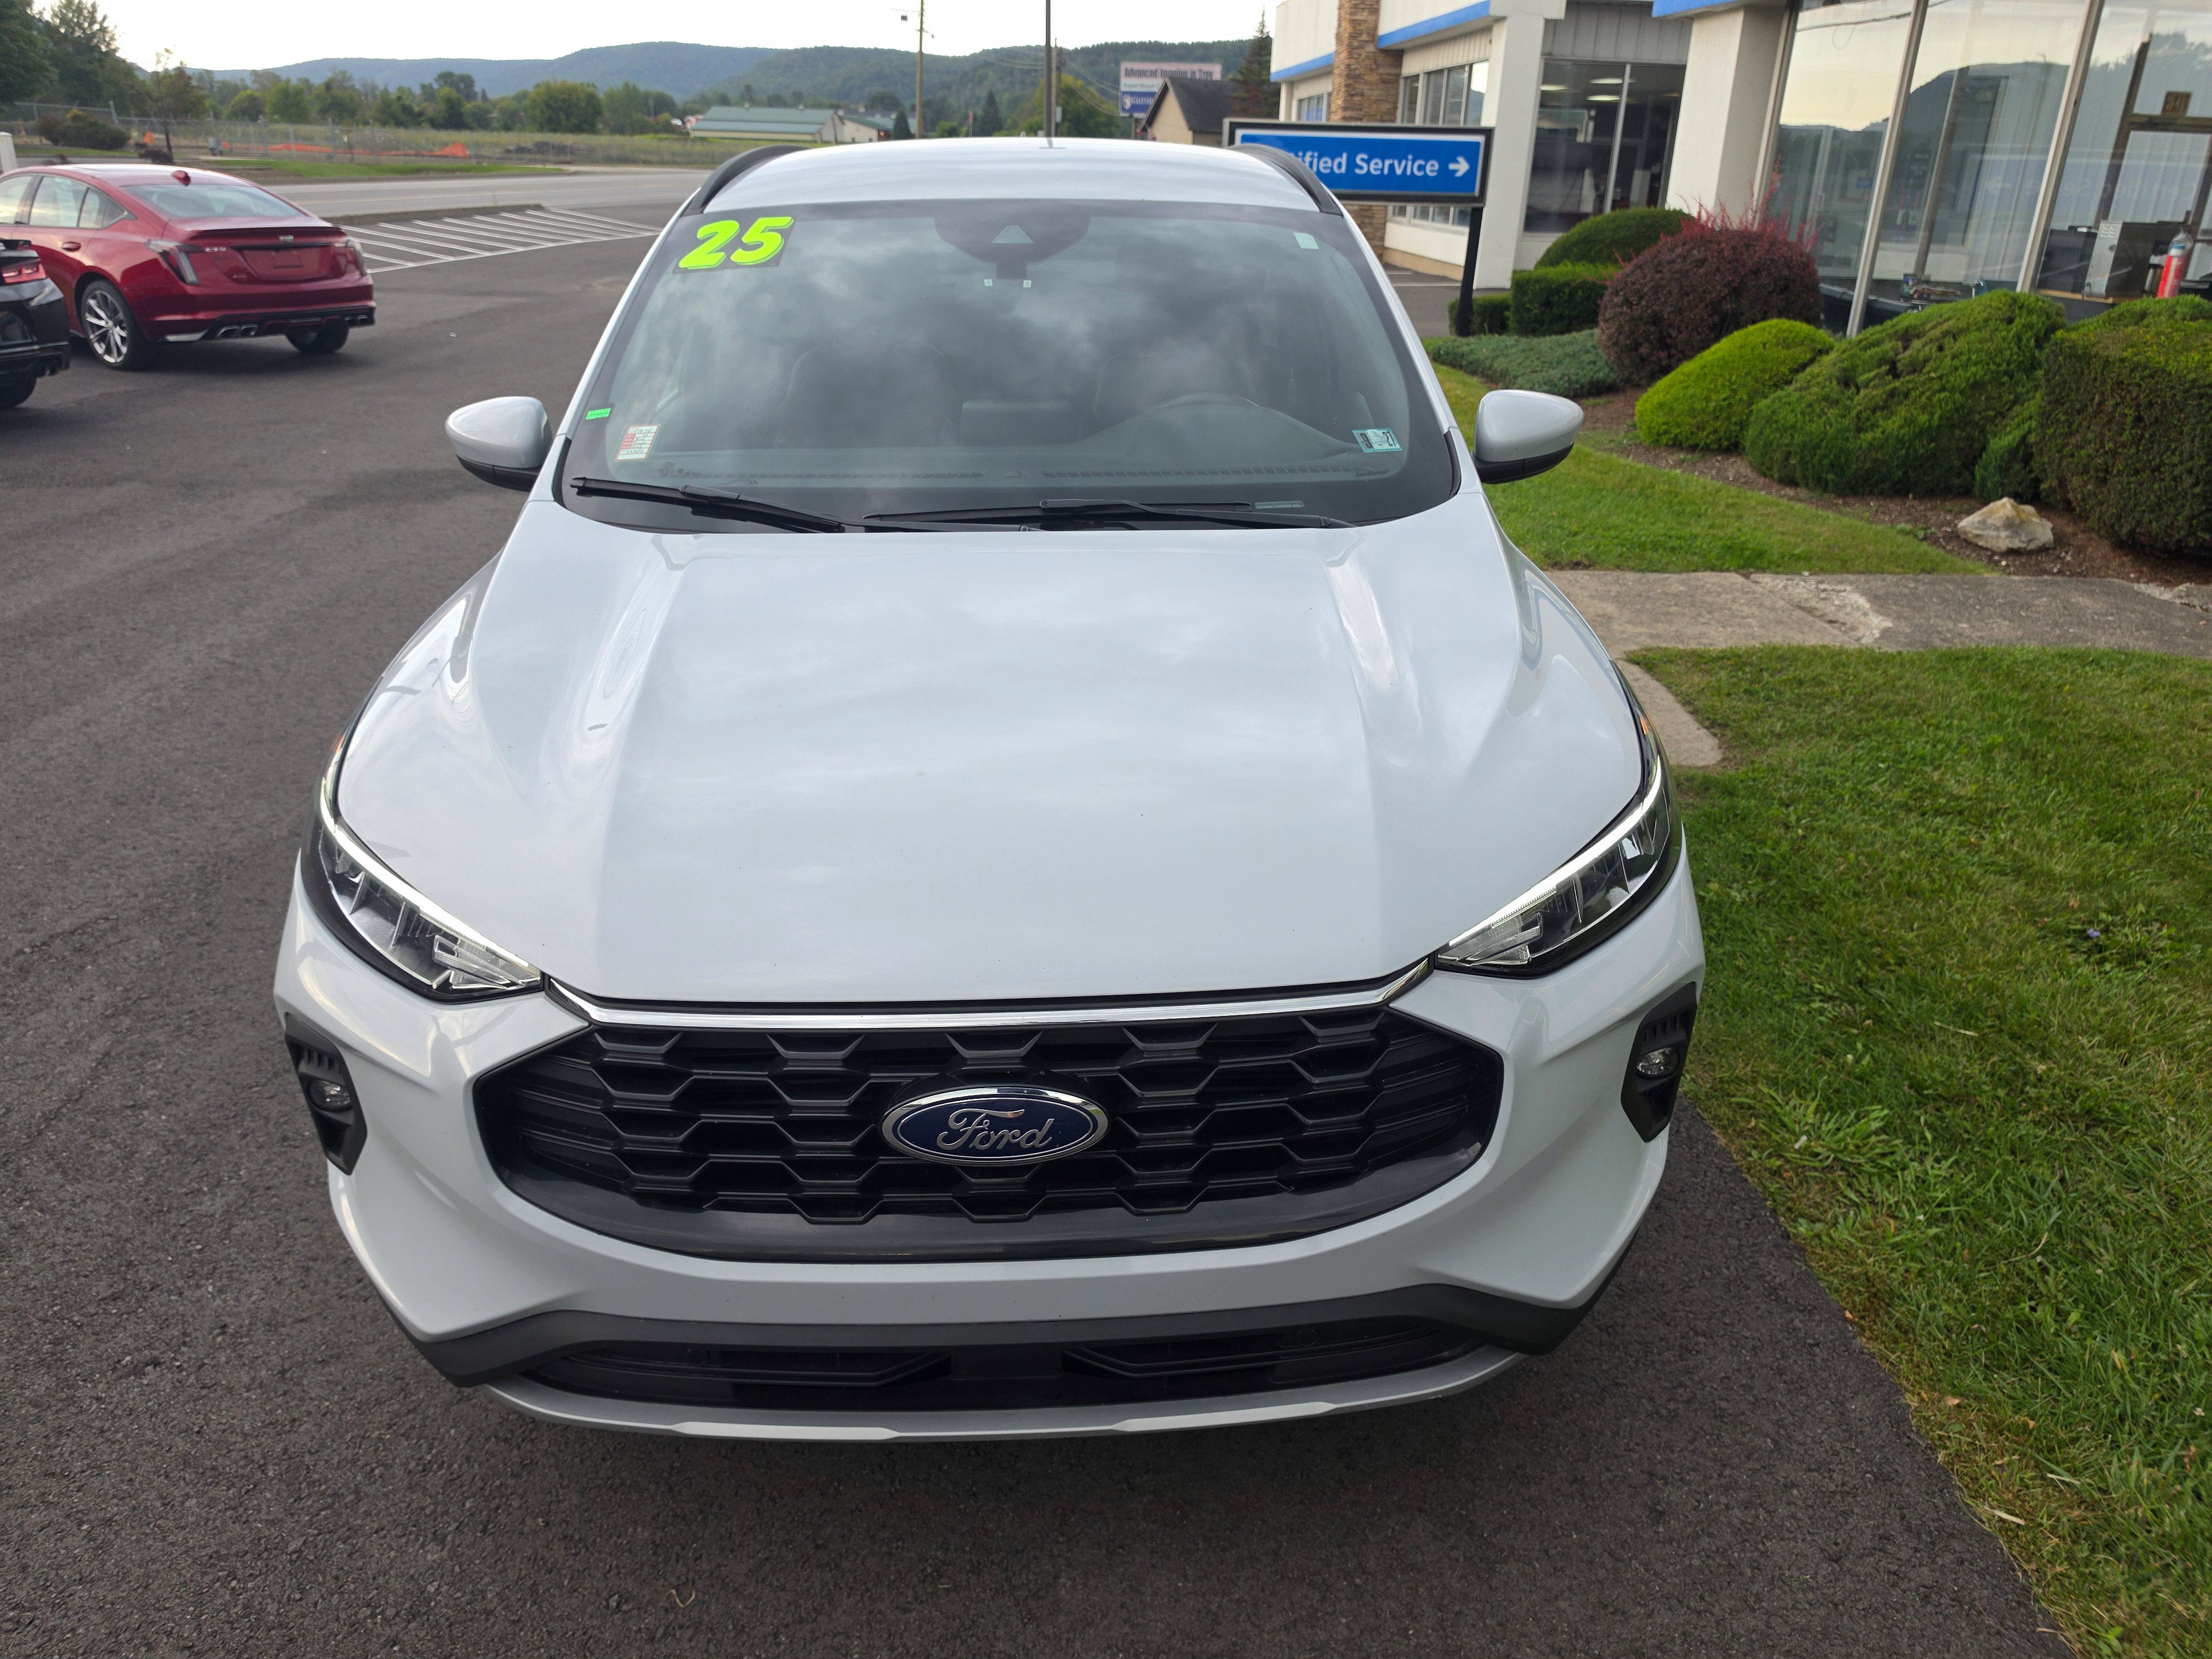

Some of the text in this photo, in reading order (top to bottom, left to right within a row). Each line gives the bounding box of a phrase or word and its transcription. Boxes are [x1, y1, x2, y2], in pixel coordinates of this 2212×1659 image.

[1354, 153, 1439, 176] Service
[679, 216, 794, 270] 25
[1360, 431, 1396, 448] 9 27
[937, 1108, 1055, 1150] Ford
